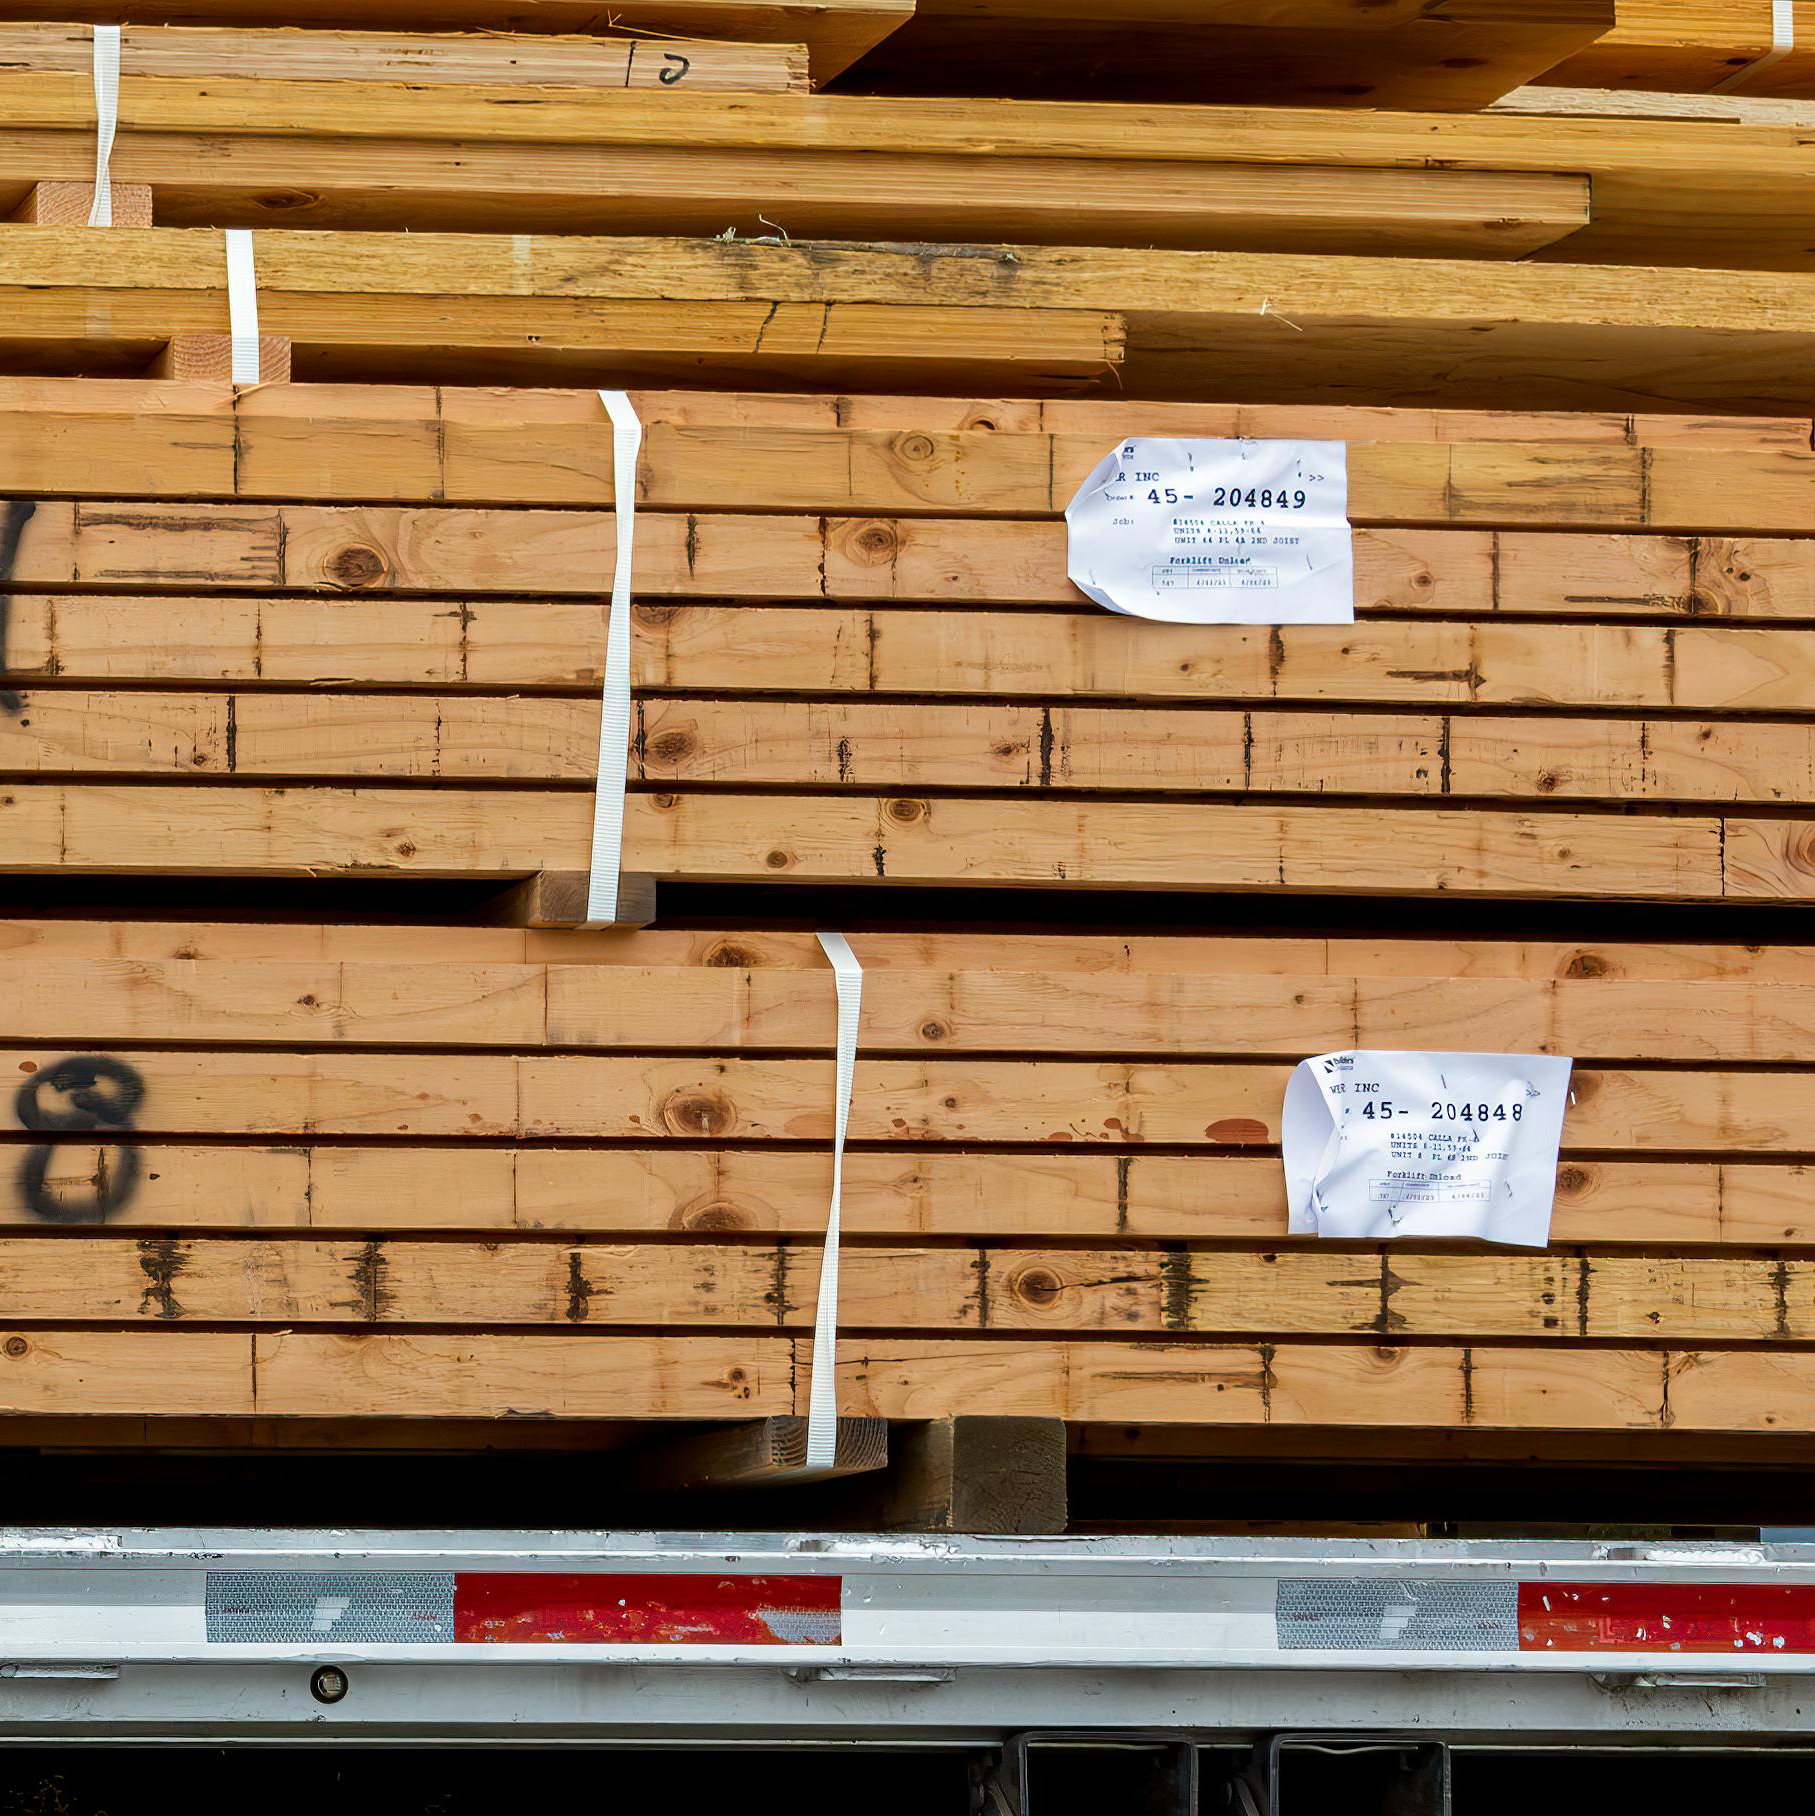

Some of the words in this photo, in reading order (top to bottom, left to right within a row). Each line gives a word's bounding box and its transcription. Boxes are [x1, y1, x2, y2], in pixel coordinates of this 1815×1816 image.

[1135, 472, 1160, 482] INC
[1147, 488, 1194, 504] 45-
[1212, 487, 1306, 509] 204849
[1354, 1083, 1380, 1093] INC
[1362, 1101, 1409, 1119] 45-
[1431, 1101, 1523, 1122] 204848
[15, 1054, 147, 1224] 8
